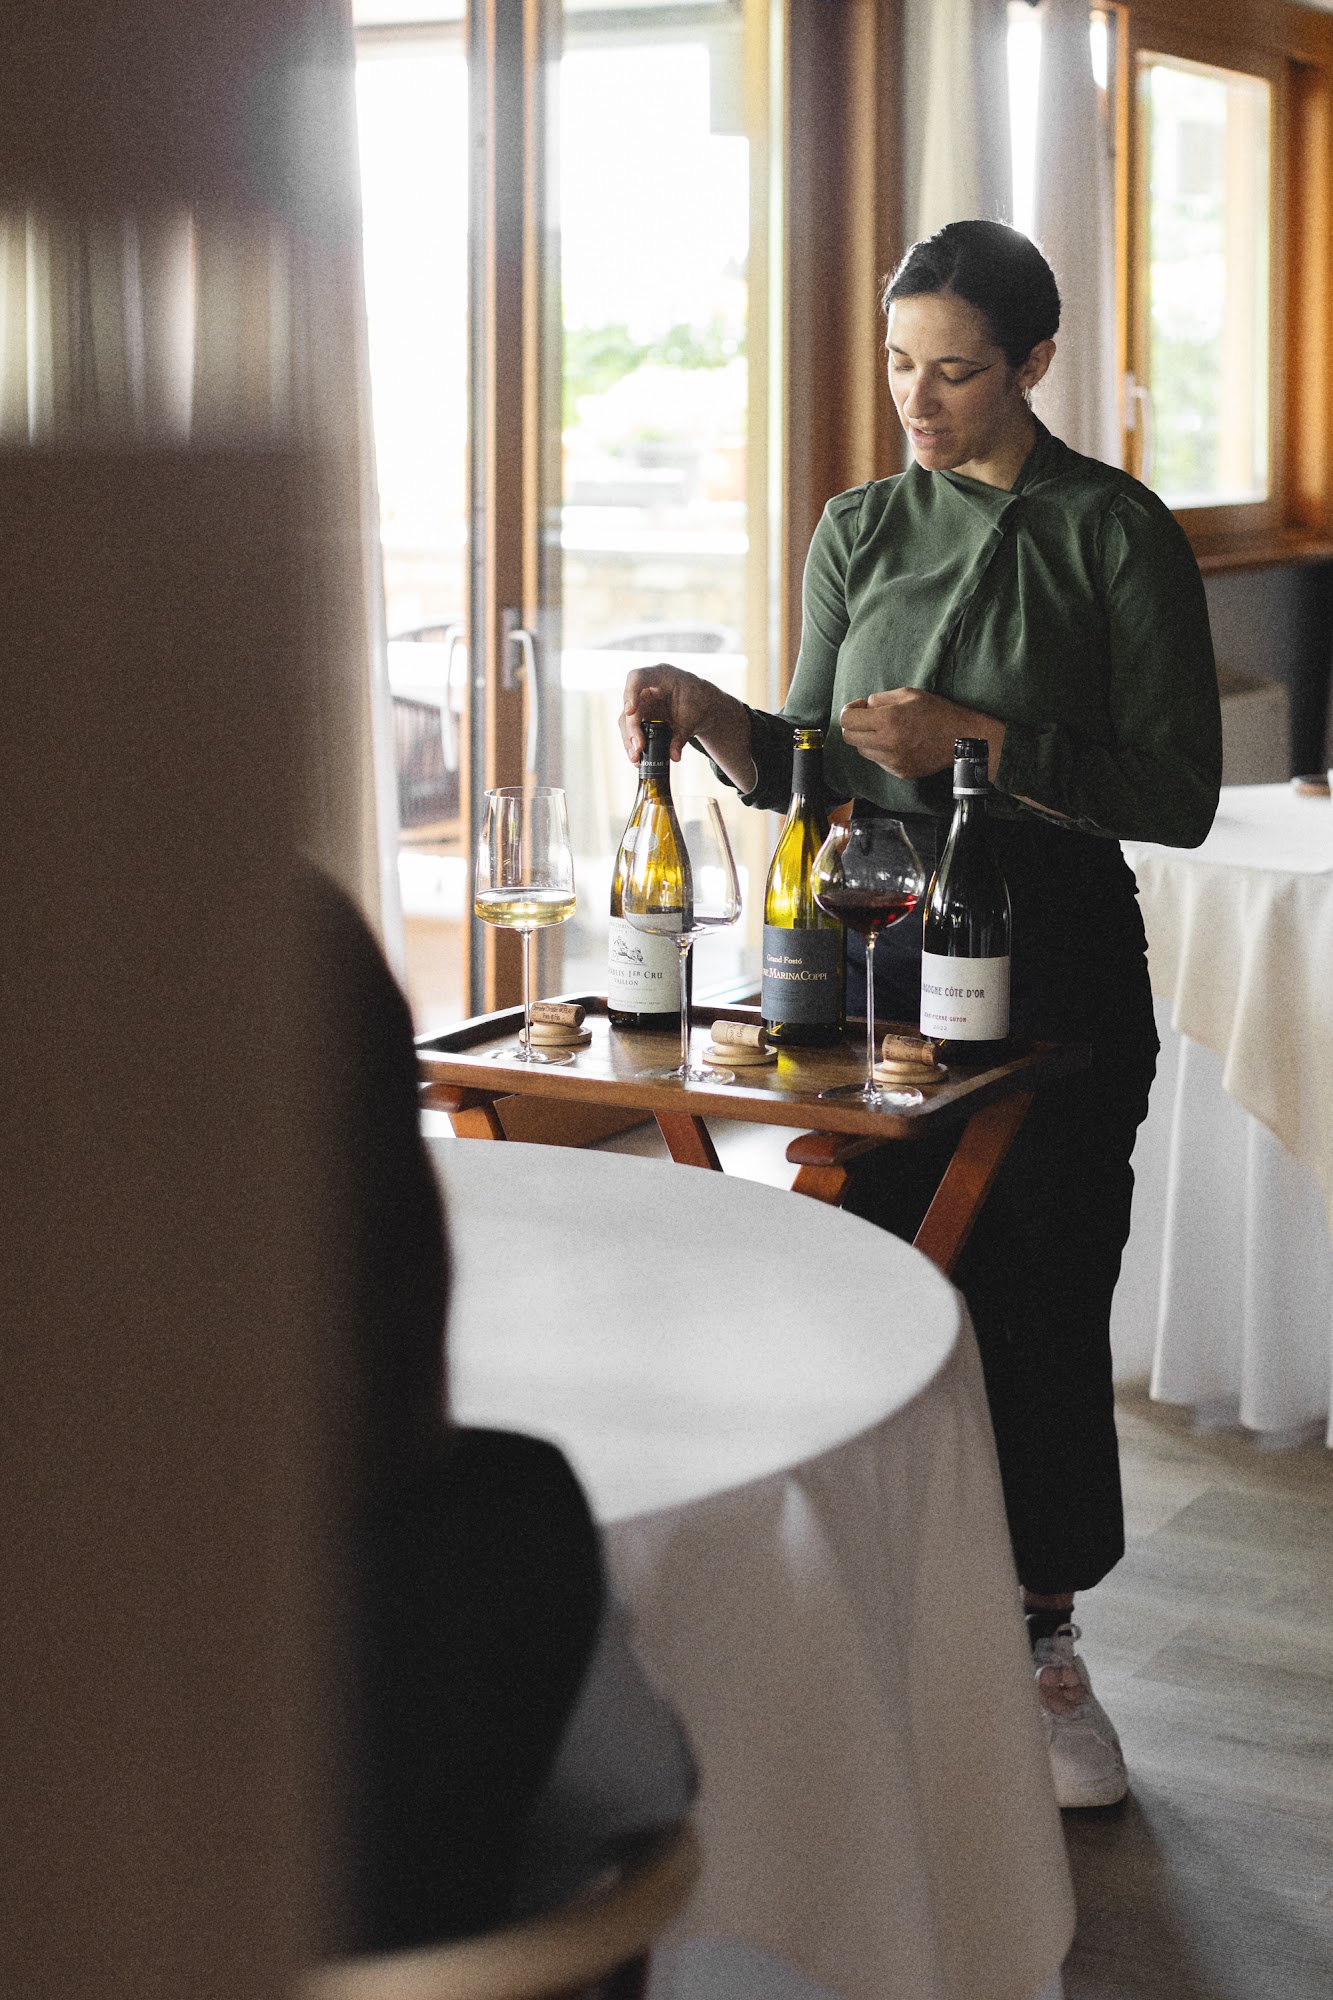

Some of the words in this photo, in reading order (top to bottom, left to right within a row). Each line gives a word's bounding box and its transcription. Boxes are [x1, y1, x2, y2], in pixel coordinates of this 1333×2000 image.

[766, 953, 783, 964] Grand
[643, 971, 663, 979] CRU
[769, 967, 801, 981] MARINA
[800, 970, 828, 981] COPPI
[944, 986, 964, 998] CÔTE
[966, 989, 986, 999] D'OR
